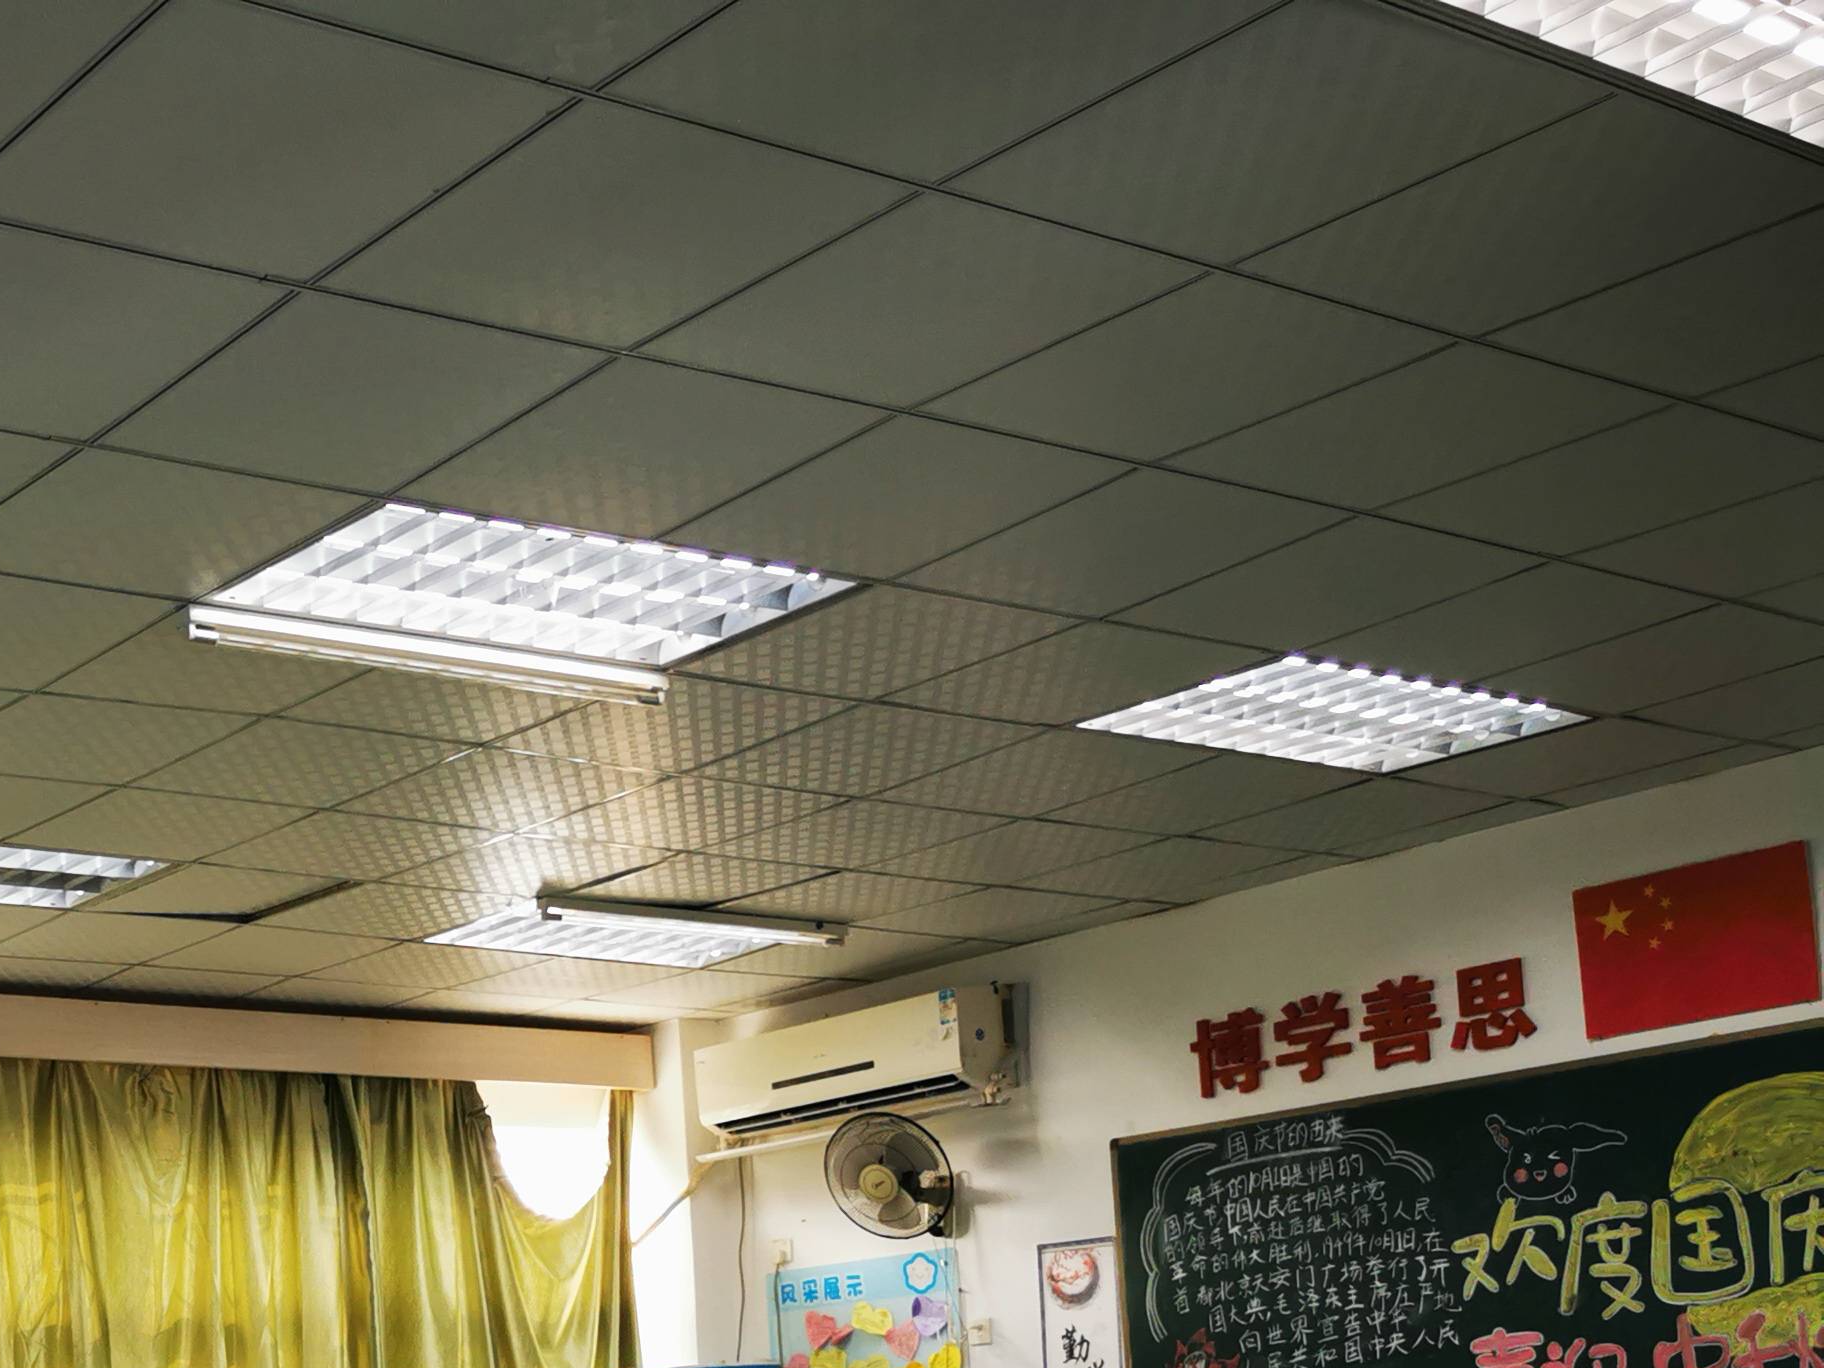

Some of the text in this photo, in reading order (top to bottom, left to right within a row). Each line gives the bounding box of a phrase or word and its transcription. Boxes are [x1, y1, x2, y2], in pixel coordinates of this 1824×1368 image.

[1190, 957, 1538, 1099] 博学善思
[780, 1274, 864, 1305] 风采展示
[1238, 1308, 1408, 1354] 向世界宣告中华
